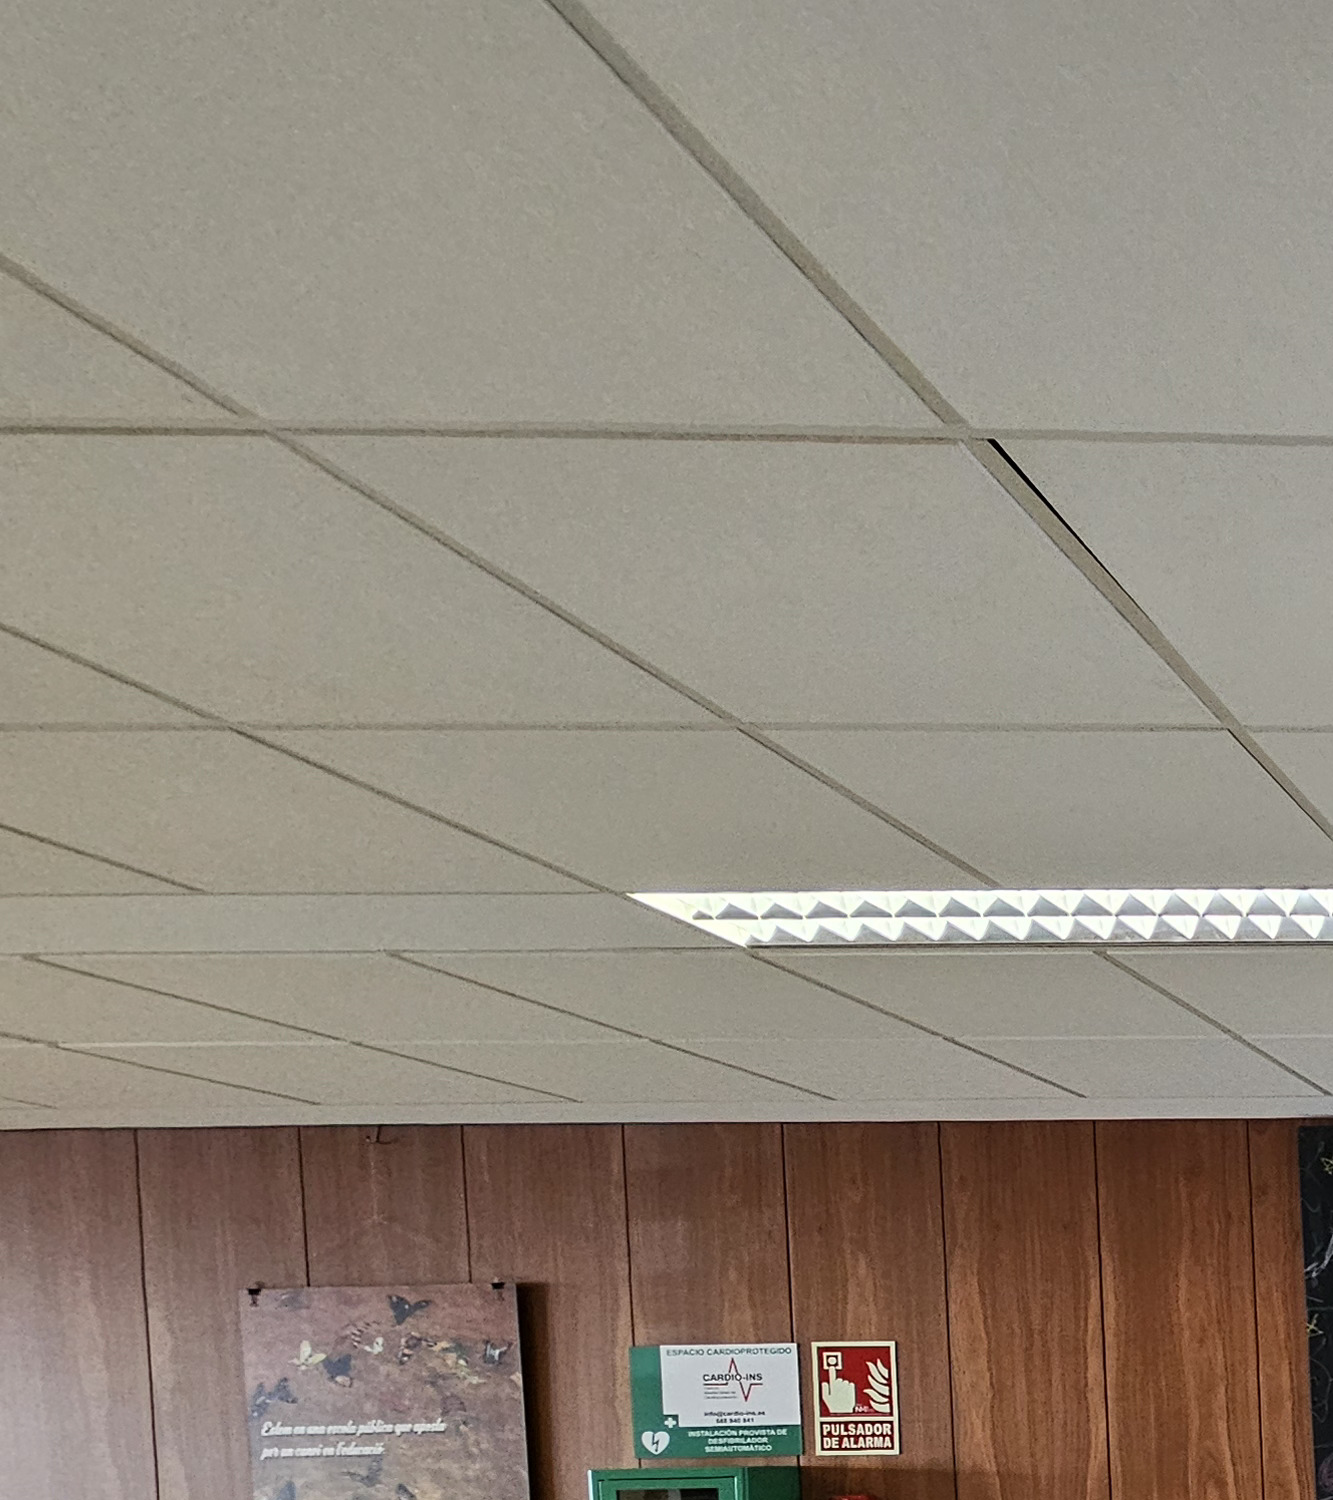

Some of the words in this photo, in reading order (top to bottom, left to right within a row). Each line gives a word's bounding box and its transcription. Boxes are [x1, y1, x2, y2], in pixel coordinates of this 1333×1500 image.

[667, 1348, 704, 1357] ESPACIO
[707, 1347, 792, 1356] CARDIOPROTEGIDO
[703, 1373, 763, 1383] CARDIO-INS
[688, 1429, 737, 1438] INSTALACIÓN
[739, 1429, 775, 1437] PROVISTA
[776, 1428, 788, 1436] DE
[822, 1423, 892, 1436] PULSADOR
[708, 1437, 769, 1445] DESFIBRILADOR
[823, 1437, 840, 1449] DE
[841, 1436, 892, 1449] ALARMA
[704, 1443, 772, 1453] SEMIAUTOMÁTICO
